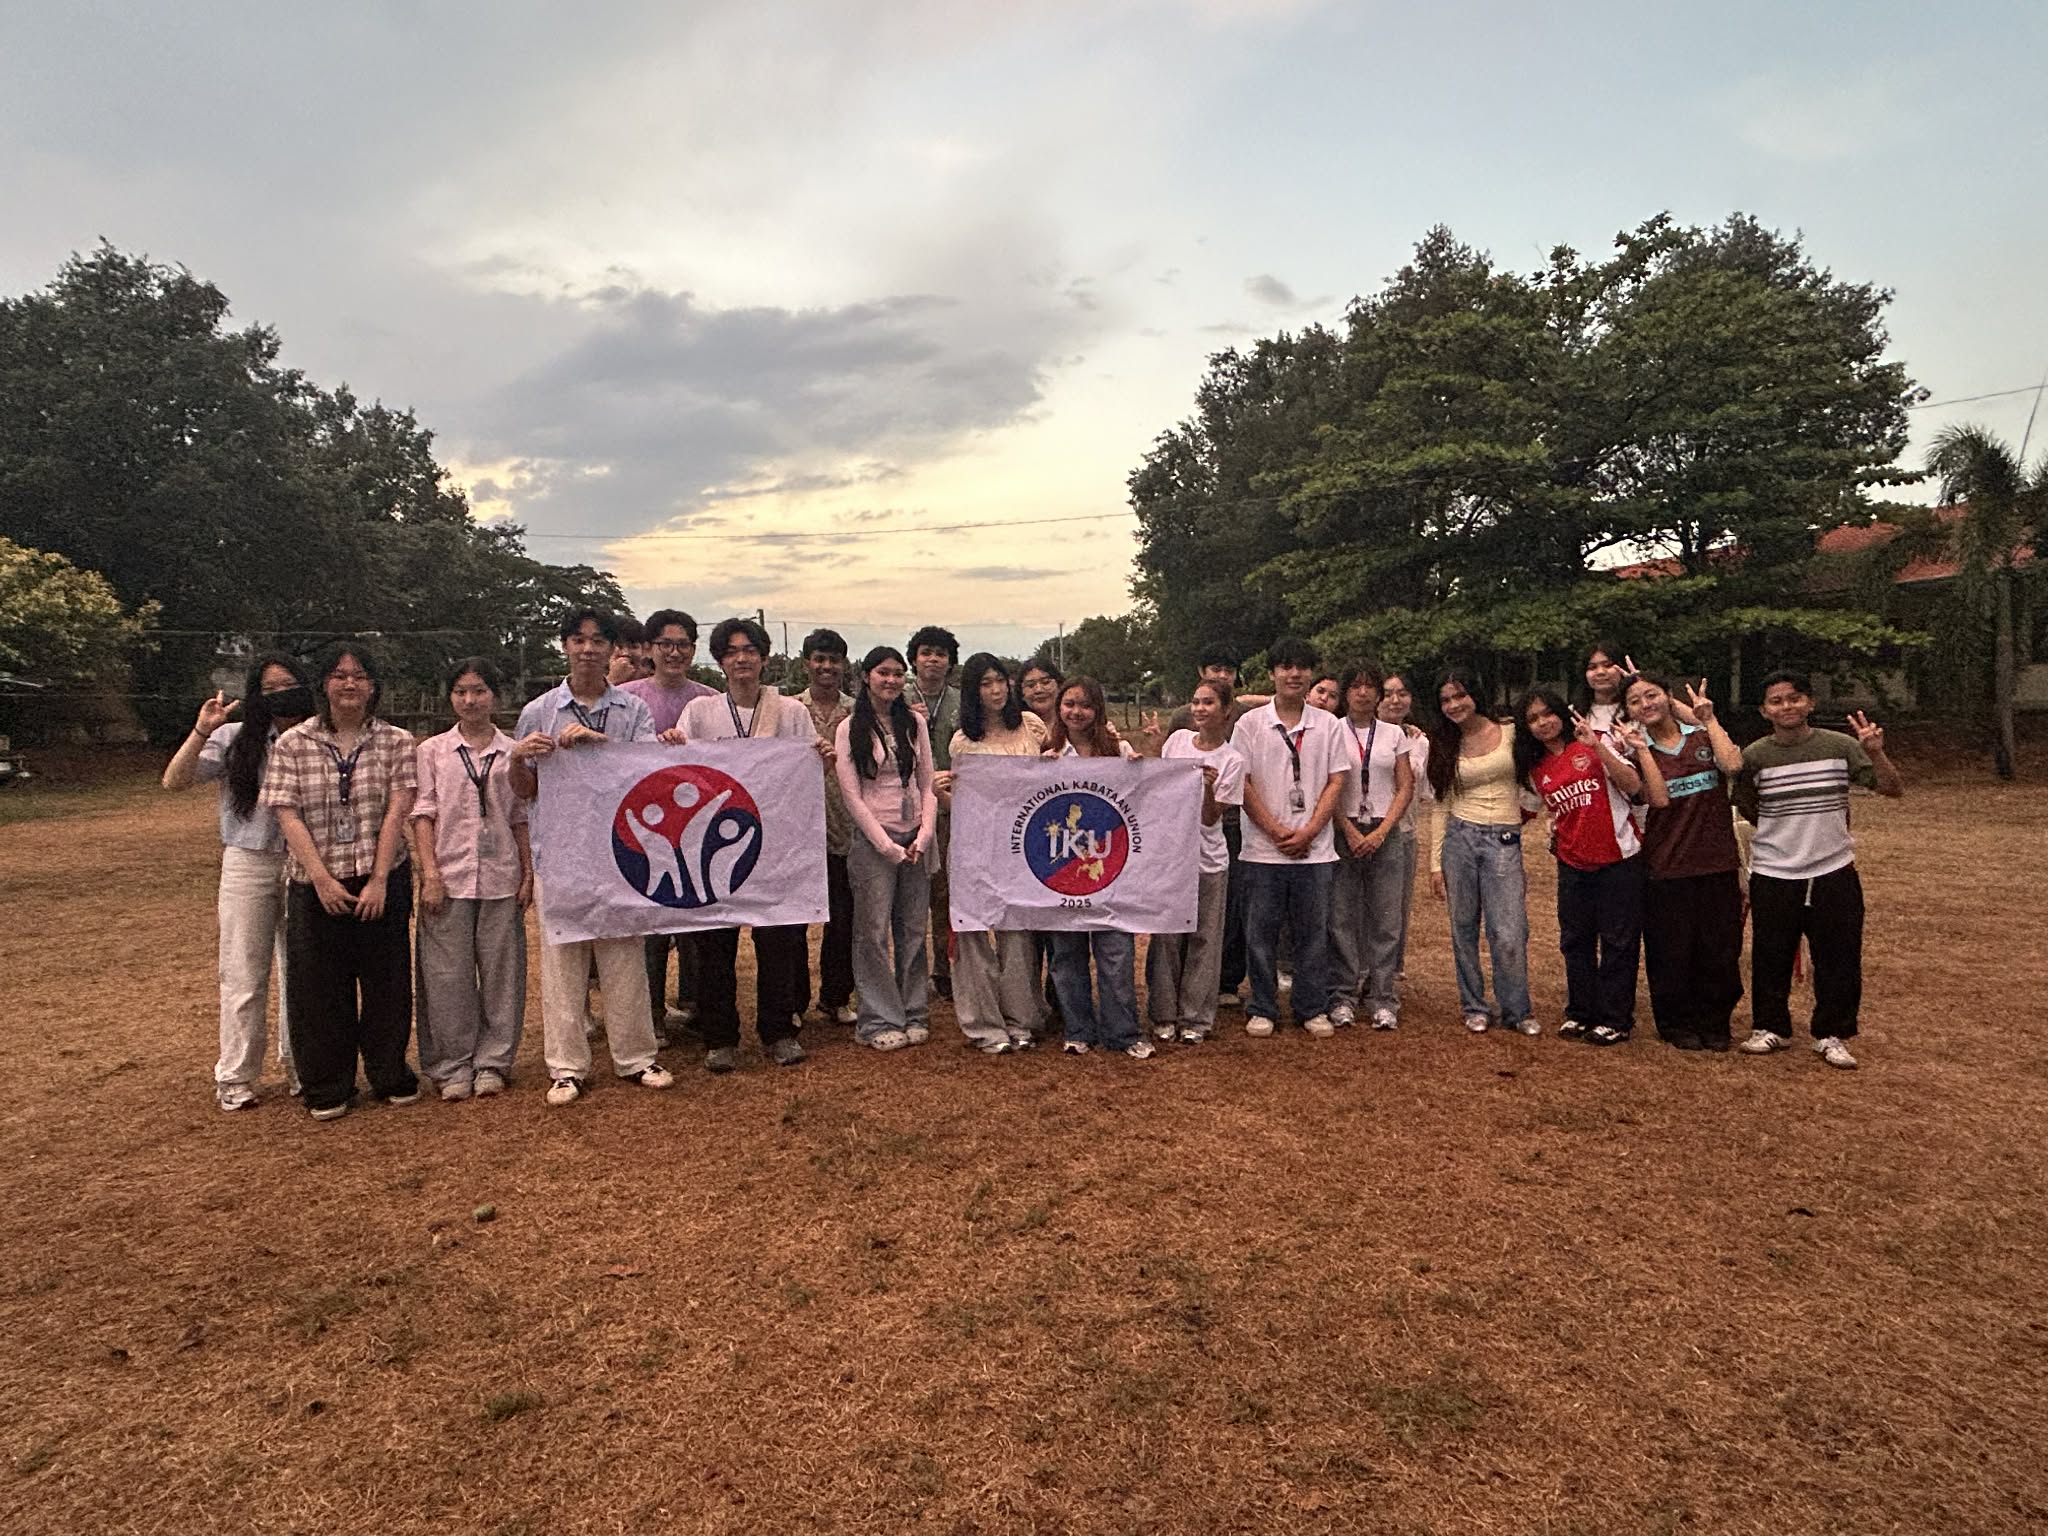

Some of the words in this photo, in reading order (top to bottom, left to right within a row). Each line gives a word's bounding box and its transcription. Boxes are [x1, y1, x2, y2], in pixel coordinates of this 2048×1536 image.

[1545, 778, 1600, 807] Emirates
[1667, 779, 1702, 794] didas
[1011, 781, 1069, 854] INTERNATIONAL
[1072, 780, 1131, 814] KABATAAN
[1127, 814, 1142, 853] UNION
[1049, 828, 1112, 859] IKU
[1060, 897, 1092, 909] 2025
